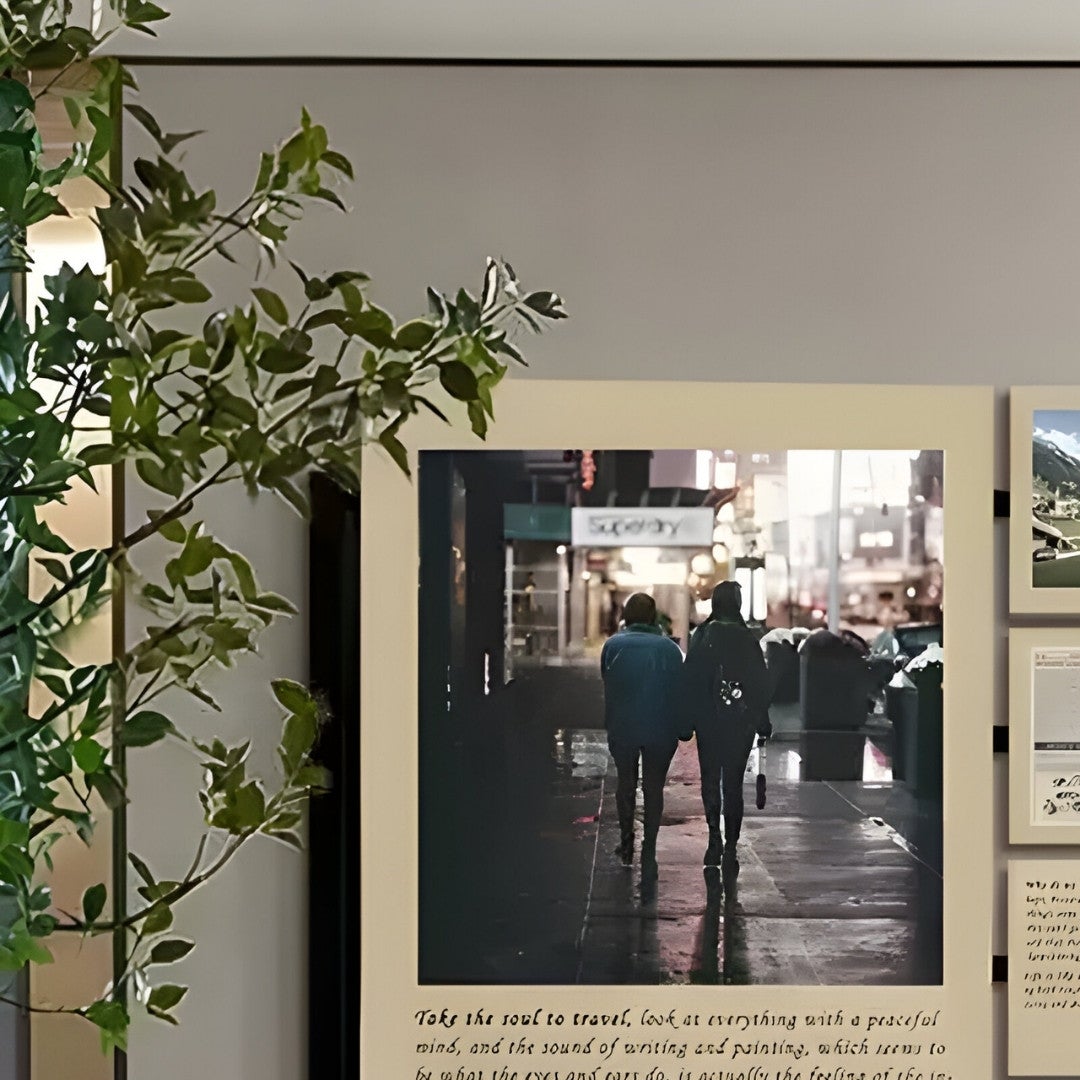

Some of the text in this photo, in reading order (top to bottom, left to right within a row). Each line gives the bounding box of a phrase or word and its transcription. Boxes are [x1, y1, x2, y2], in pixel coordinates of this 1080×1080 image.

[414, 1007, 459, 1029] Take
[465, 1007, 494, 1026] the
[501, 1007, 544, 1027] soul
[546, 1012, 565, 1027] to
[640, 1008, 680, 1030] look
[682, 1014, 700, 1027] at
[707, 1009, 798, 1032] everything
[804, 1009, 844, 1027] with
[850, 1015, 861, 1027] a
[866, 1009, 941, 1032] peaceful
[415, 1036, 462, 1057] mind,
[469, 1036, 505, 1055] and
[508, 1036, 535, 1056] the
[541, 1036, 597, 1055] sound
[599, 1036, 621, 1061] of
[624, 1038, 688, 1059] writing
[694, 1037, 730, 1055] and
[817, 1037, 869, 1055] which
[875, 1043, 922, 1056] seems
[929, 1042, 946, 1056] to
